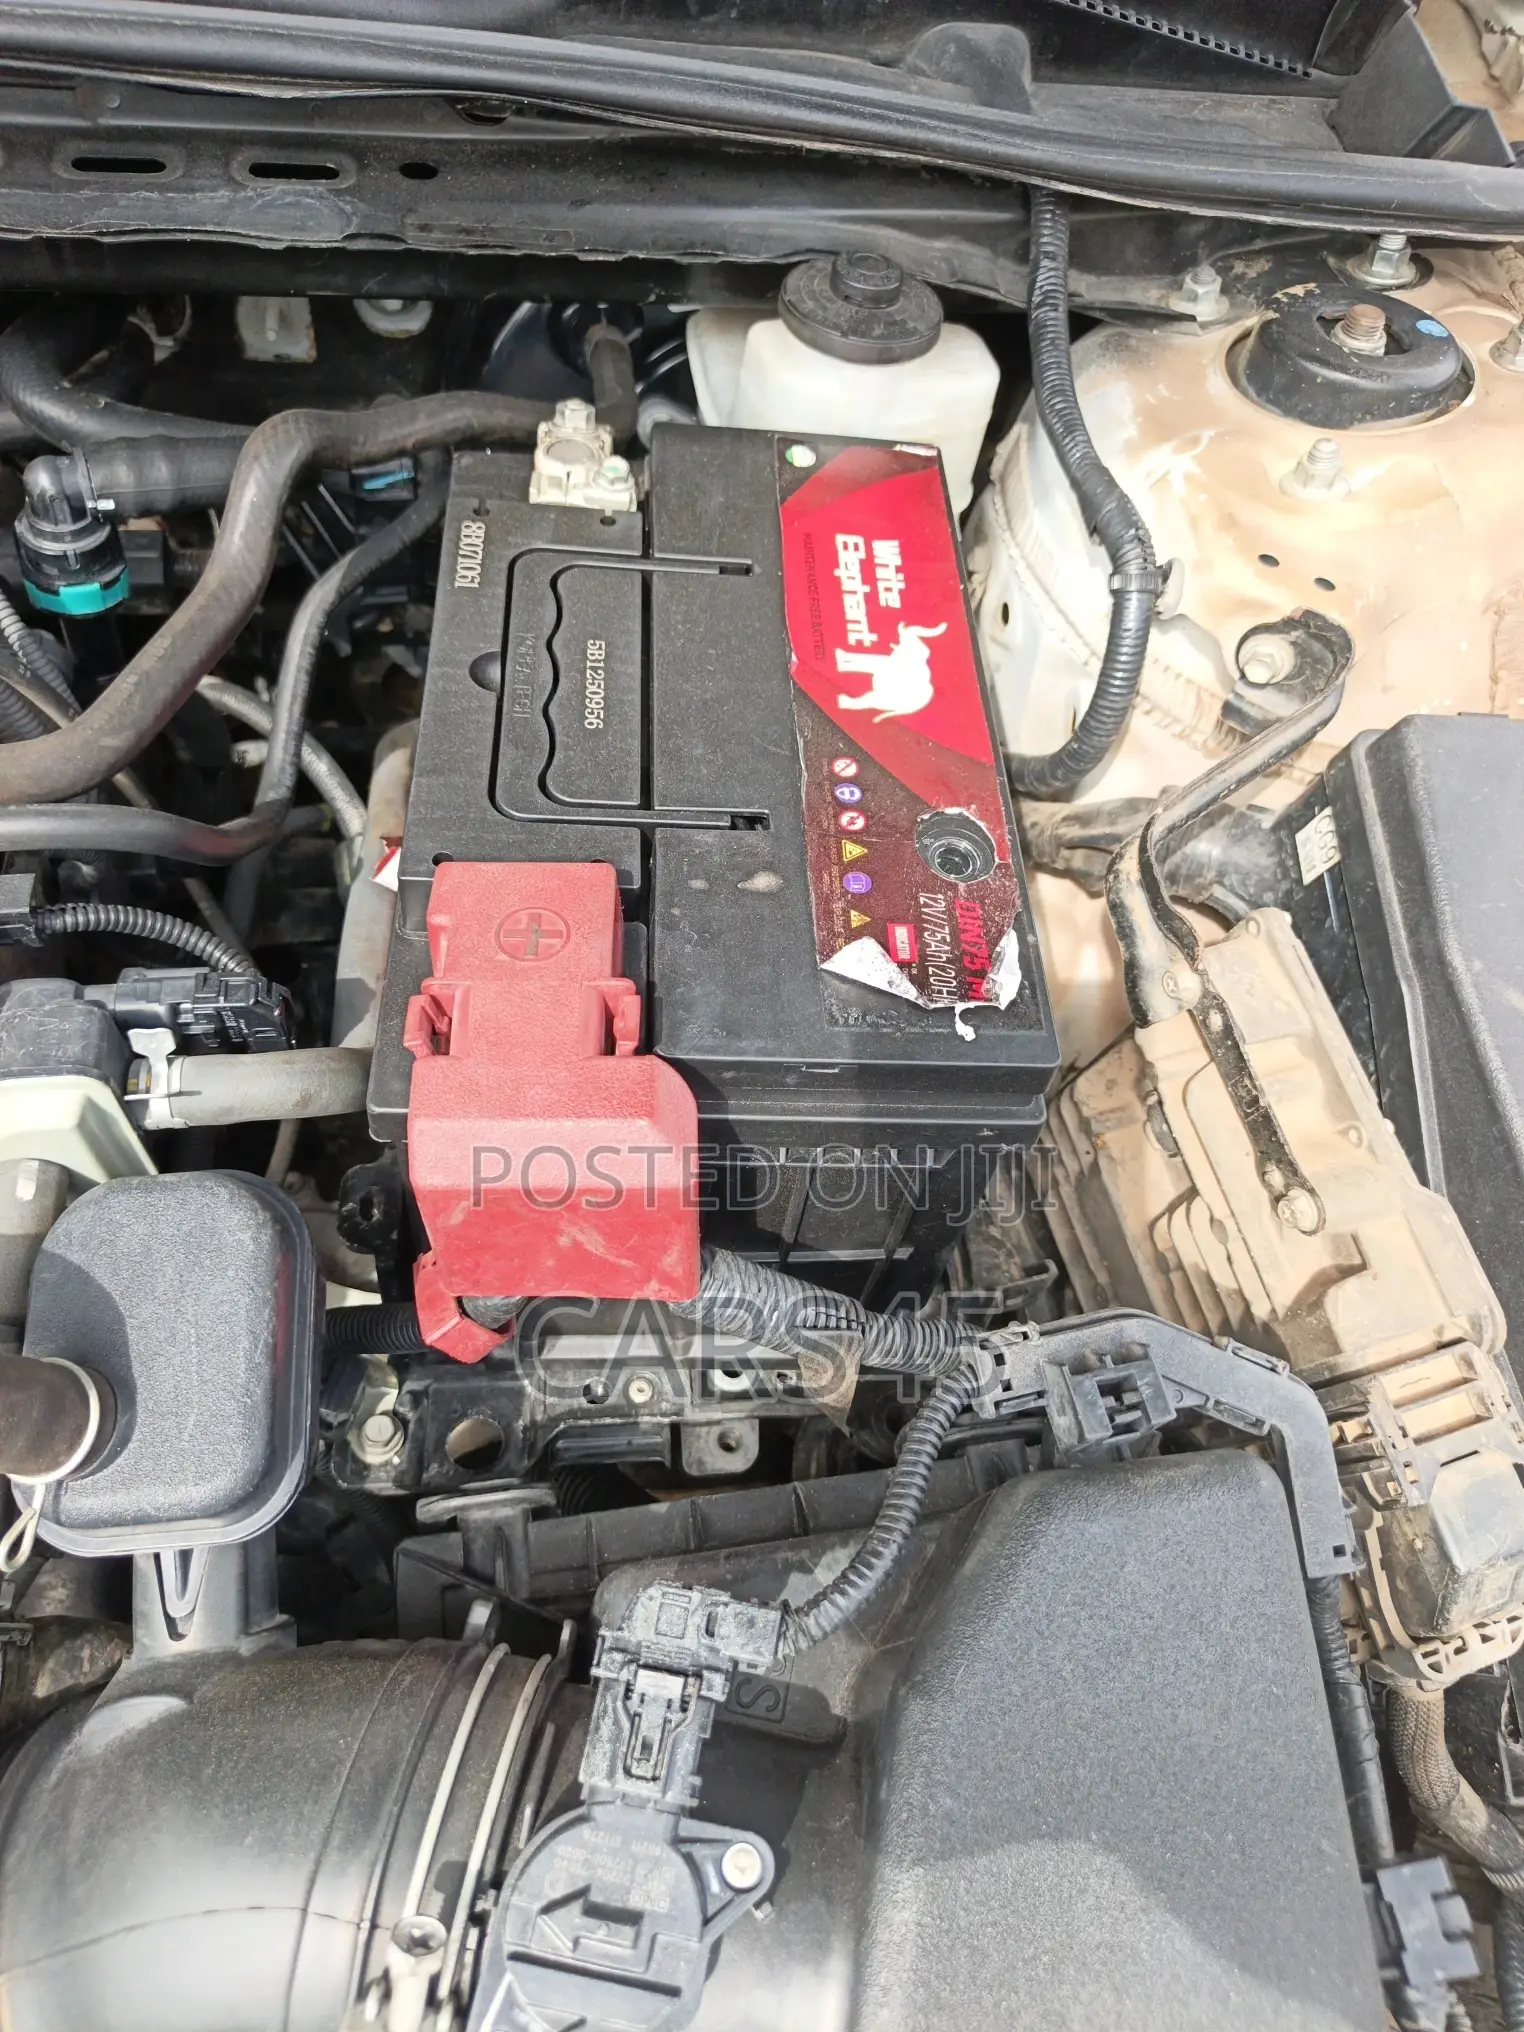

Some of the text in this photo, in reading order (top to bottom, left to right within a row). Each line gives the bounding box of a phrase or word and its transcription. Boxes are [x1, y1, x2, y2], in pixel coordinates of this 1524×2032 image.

[454, 520, 485, 588] 8B071061
[834, 533, 878, 647] Elephant
[872, 540, 905, 609] White
[802, 532, 826, 662] MAINTENANCE FREE BATTERY
[584, 639, 606, 729] 5B1250956
[894, 925, 911, 960] INDICATOR
[954, 898, 992, 972] DIN75
